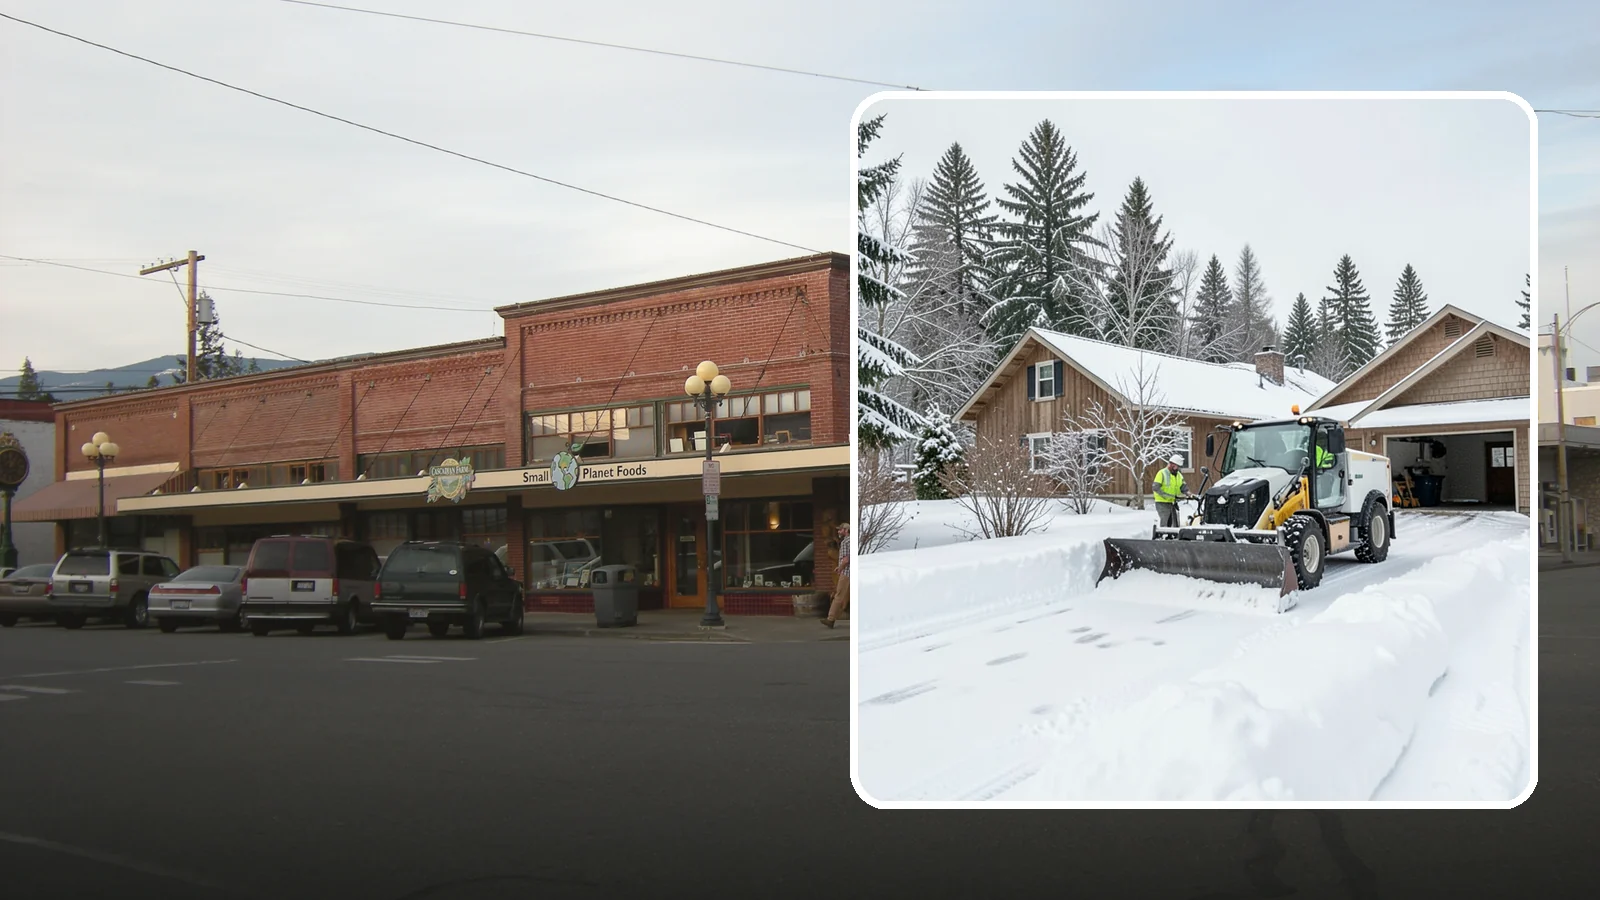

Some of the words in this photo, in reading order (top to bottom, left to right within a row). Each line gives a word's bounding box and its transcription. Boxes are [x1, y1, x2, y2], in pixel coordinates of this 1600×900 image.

[523, 470, 549, 483] Small
[582, 467, 614, 479] Planet
[617, 464, 647, 477] Foods
